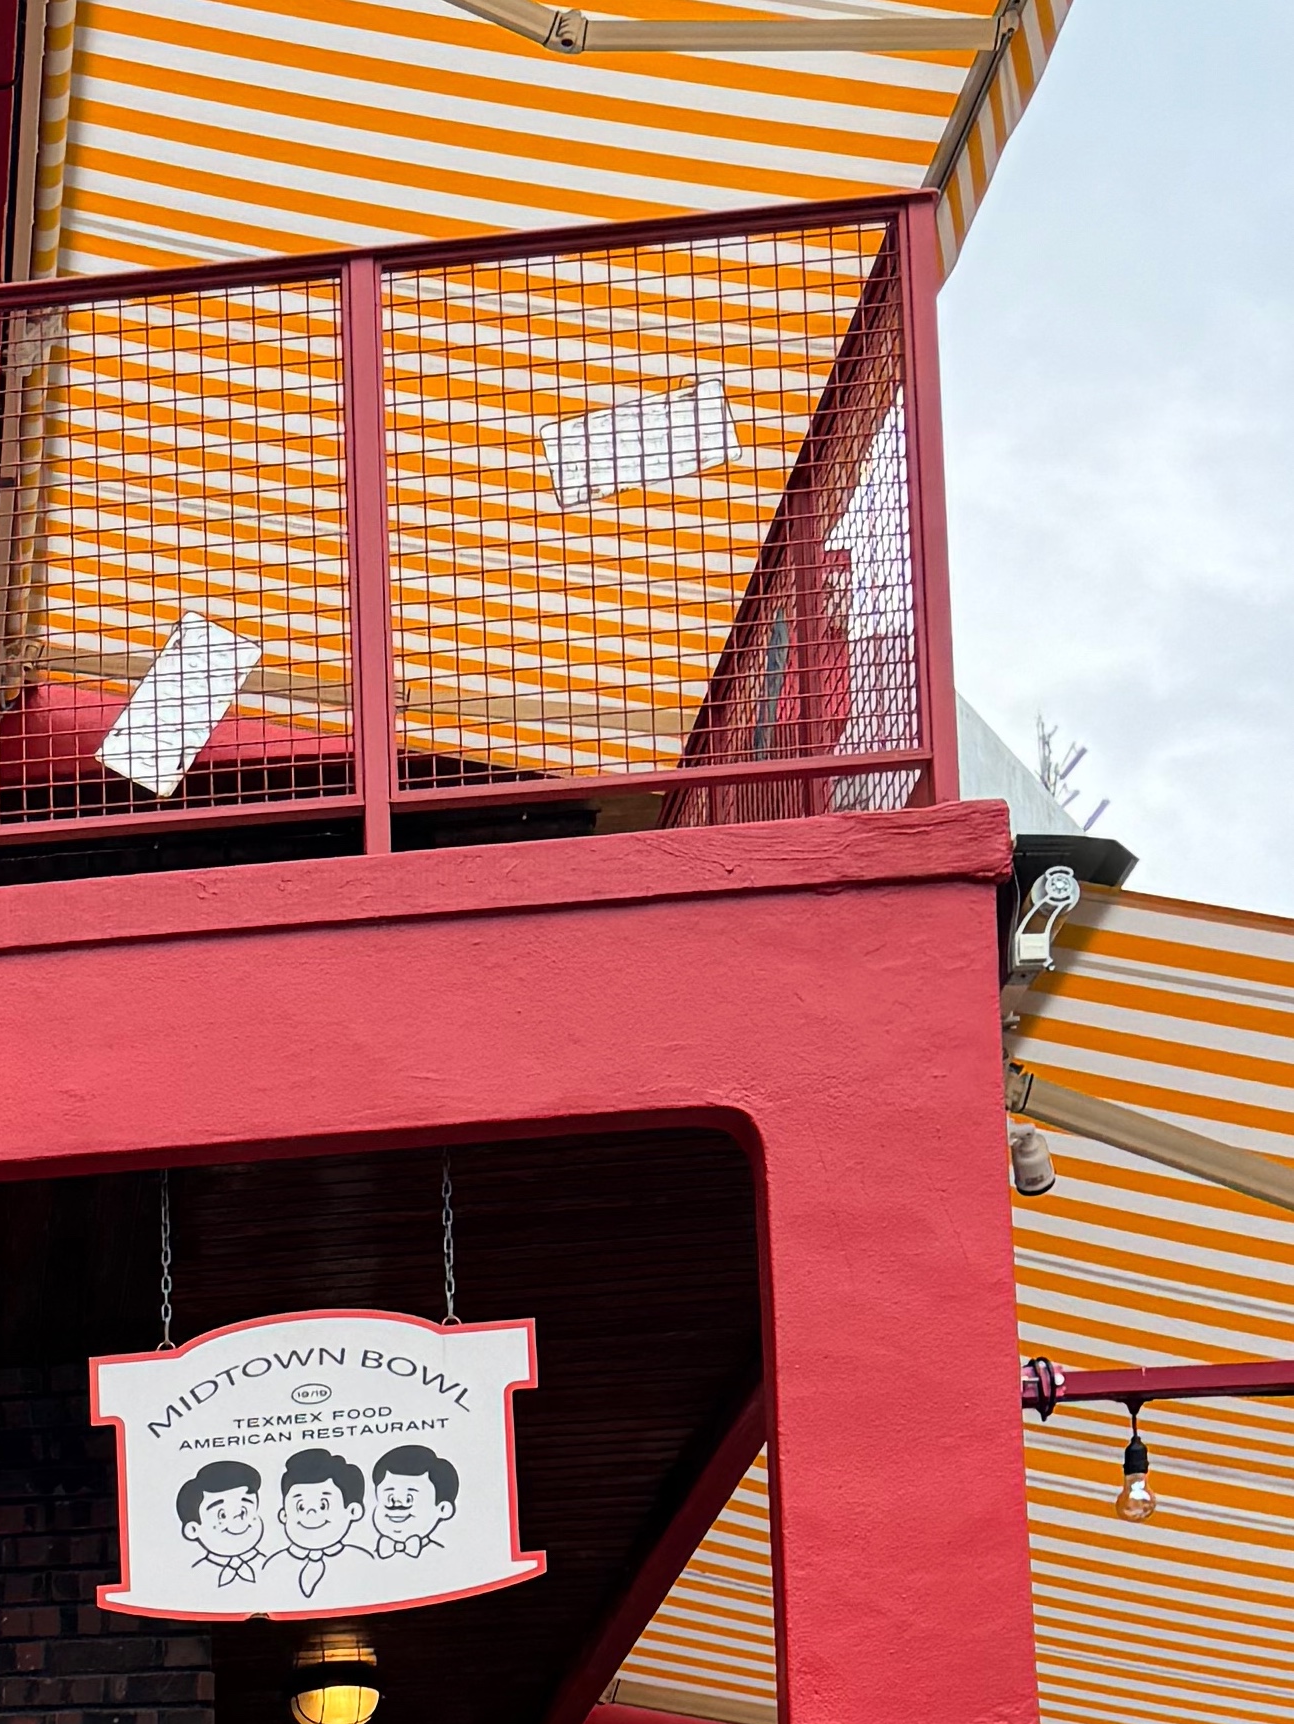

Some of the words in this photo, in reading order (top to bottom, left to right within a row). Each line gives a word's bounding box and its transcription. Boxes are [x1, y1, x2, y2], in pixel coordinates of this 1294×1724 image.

[147, 1347, 346, 1439] MIDTOWN
[361, 1349, 471, 1413] BOWL
[178, 1431, 293, 1451] AMERICAN
[302, 1417, 450, 1440] RESTAURANT
[232, 1411, 322, 1429] TEXMEX
[332, 1406, 393, 1421] FOOD
